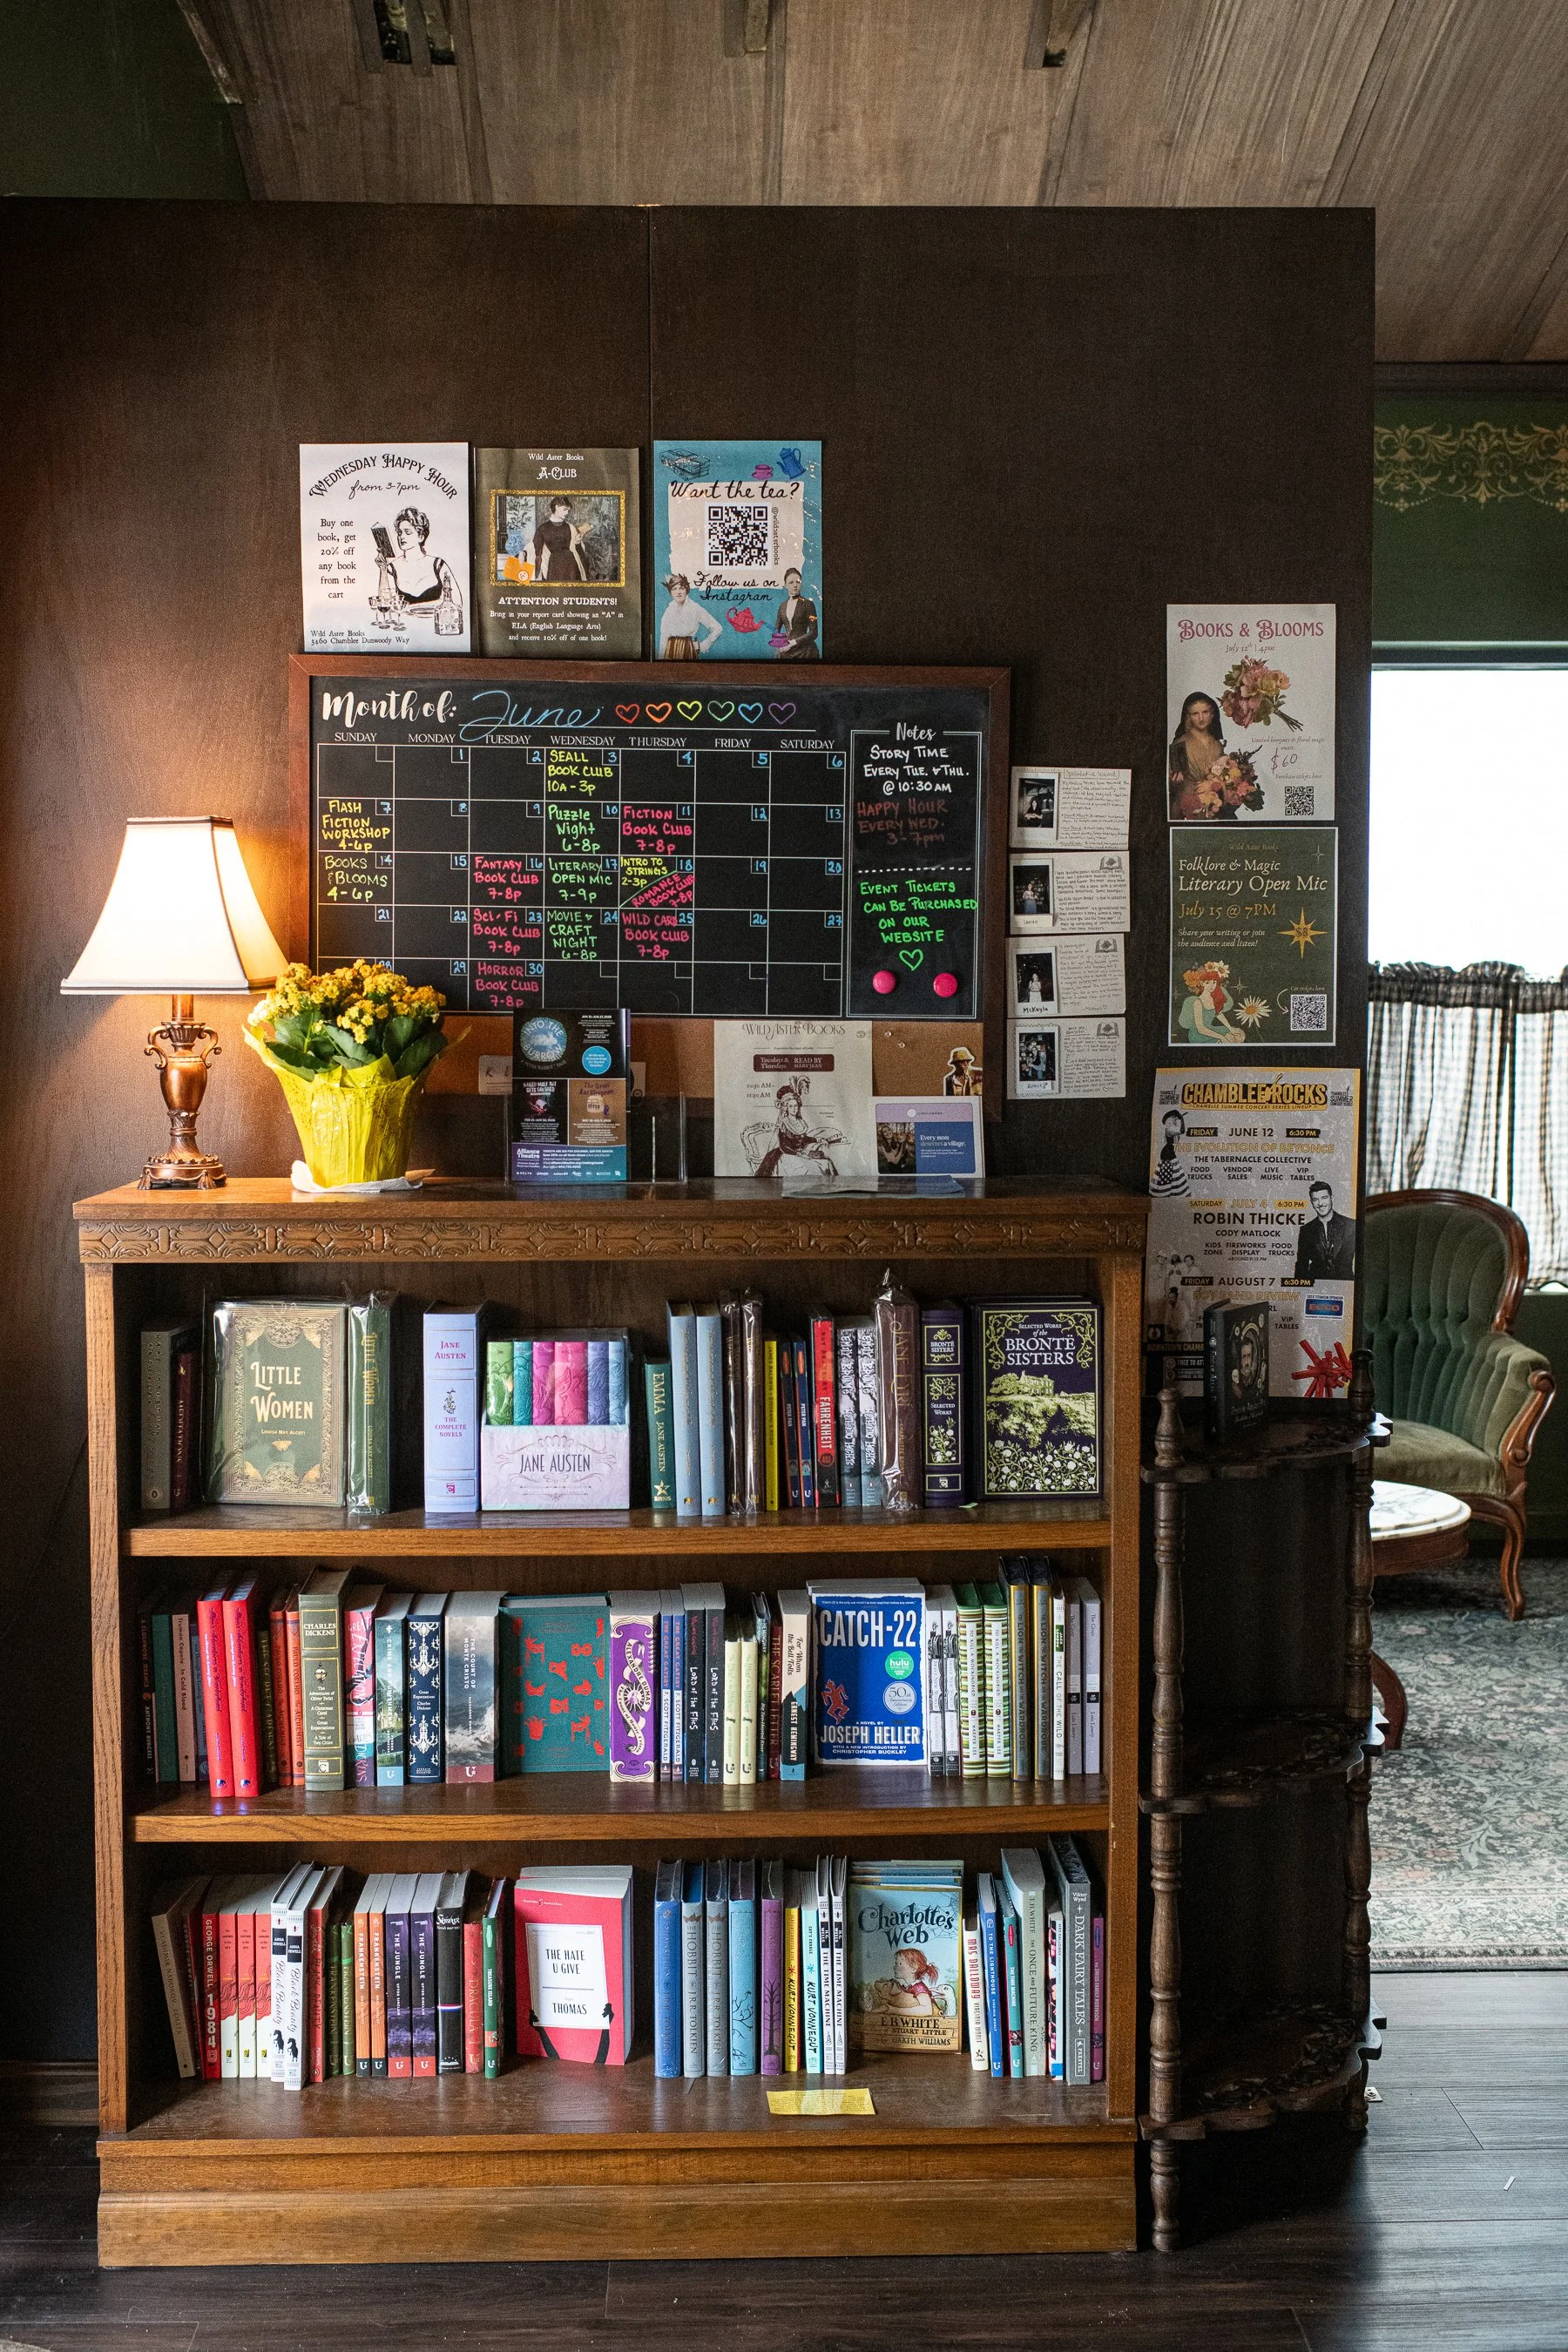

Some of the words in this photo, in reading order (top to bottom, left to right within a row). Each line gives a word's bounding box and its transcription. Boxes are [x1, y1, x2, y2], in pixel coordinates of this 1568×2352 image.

[309, 456, 377, 499] WEDNESDAY
[349, 480, 383, 500] from
[670, 480, 722, 499] Want
[725, 480, 757, 498] the
[760, 482, 801, 500] tea?
[321, 518, 336, 529] Buy
[317, 532, 340, 542] book,
[344, 534, 356, 543] get
[321, 547, 339, 556] 20%
[343, 547, 355, 556] off
[337, 561, 356, 571] book
[693, 571, 740, 587] Follow
[498, 597, 559, 606] ATTENTION
[563, 597, 618, 606] STUDENTS!
[700, 587, 773, 605] Instagram
[1178, 619, 1233, 643] BOOKS
[1239, 624, 1250, 637] &
[322, 690, 420, 728] Month
[422, 690, 456, 723] of:
[459, 690, 603, 741] June
[335, 733, 377, 742] SUNDAY
[408, 733, 456, 743] MONDAY
[485, 734, 531, 744] TUESDAY
[551, 736, 616, 746] WEDNESDAY
[629, 737, 687, 747] THURSDAY
[714, 739, 751, 748] FRIDAY
[781, 740, 835, 749] SATURDAY
[896, 722, 936, 741] Notes
[321, 828, 390, 840] WORKSHOP
[324, 855, 368, 869] BOOKS
[1179, 857, 1227, 875] Folklore
[1229, 860, 1240, 871] &
[1245, 860, 1281, 875] Magic
[1179, 875, 1243, 896] Literary
[1248, 876, 1290, 897] Open
[1296, 875, 1328, 891] Mic
[1179, 901, 1205, 919] July
[1209, 907, 1223, 920] 15
[1227, 904, 1240, 918] @
[1245, 904, 1276, 920] 7PM
[549, 925, 592, 936] CRAFT
[879, 918, 896, 929] ON
[902, 916, 929, 928] OUR
[553, 936, 598, 948] NIGHT
[881, 929, 944, 943] WEBSITE
[1217, 929, 1240, 938] writing
[1183, 1084, 1267, 1104] CHAMBLEE
[1272, 1084, 1327, 1104] ROCKS
[1193, 1213, 1245, 1224] ROBIN
[1249, 1213, 1305, 1226] THICKE
[1219, 1277, 1265, 1286] AUGUST
[1268, 1277, 1275, 1286] 7
[1005, 1335, 1076, 1350] BRONTË
[1007, 1352, 1074, 1365] SISTERS
[652, 1372, 666, 1415] EMMA
[820, 1396, 832, 1450] FAHRENHEIT
[519, 1454, 545, 1474] JANE
[549, 1454, 591, 1472] AUSTEN
[820, 1610, 916, 1647] CATCH-22
[626, 1642, 644, 1680] ALEXANDRE
[641, 1680, 650, 1706] DUMAS
[821, 1726, 869, 1744] JOSEPH
[874, 1727, 920, 1744] HELLER
[858, 1902, 954, 1933] Charlotte's
[884, 1923, 929, 1950] Web
[1075, 1916, 1084, 1946] DARK
[545, 1949, 562, 1960] THE
[564, 1950, 585, 1961] HATE
[687, 1931, 697, 1981] HOBBIT
[553, 1963, 558, 1973] U
[561, 1964, 581, 1974] GIVE
[1075, 1948, 1085, 1983] FAIRY
[807, 1981, 817, 2005] KURT
[470, 1979, 478, 2031] DRACULA
[552, 2003, 587, 2015] THOMAS
[1075, 1984, 1085, 2024] TALES
[207, 1993, 216, 2048] 1984
[807, 2007, 817, 2053] VONNEGUT
[689, 2017, 698, 2054] TOLKIEN
